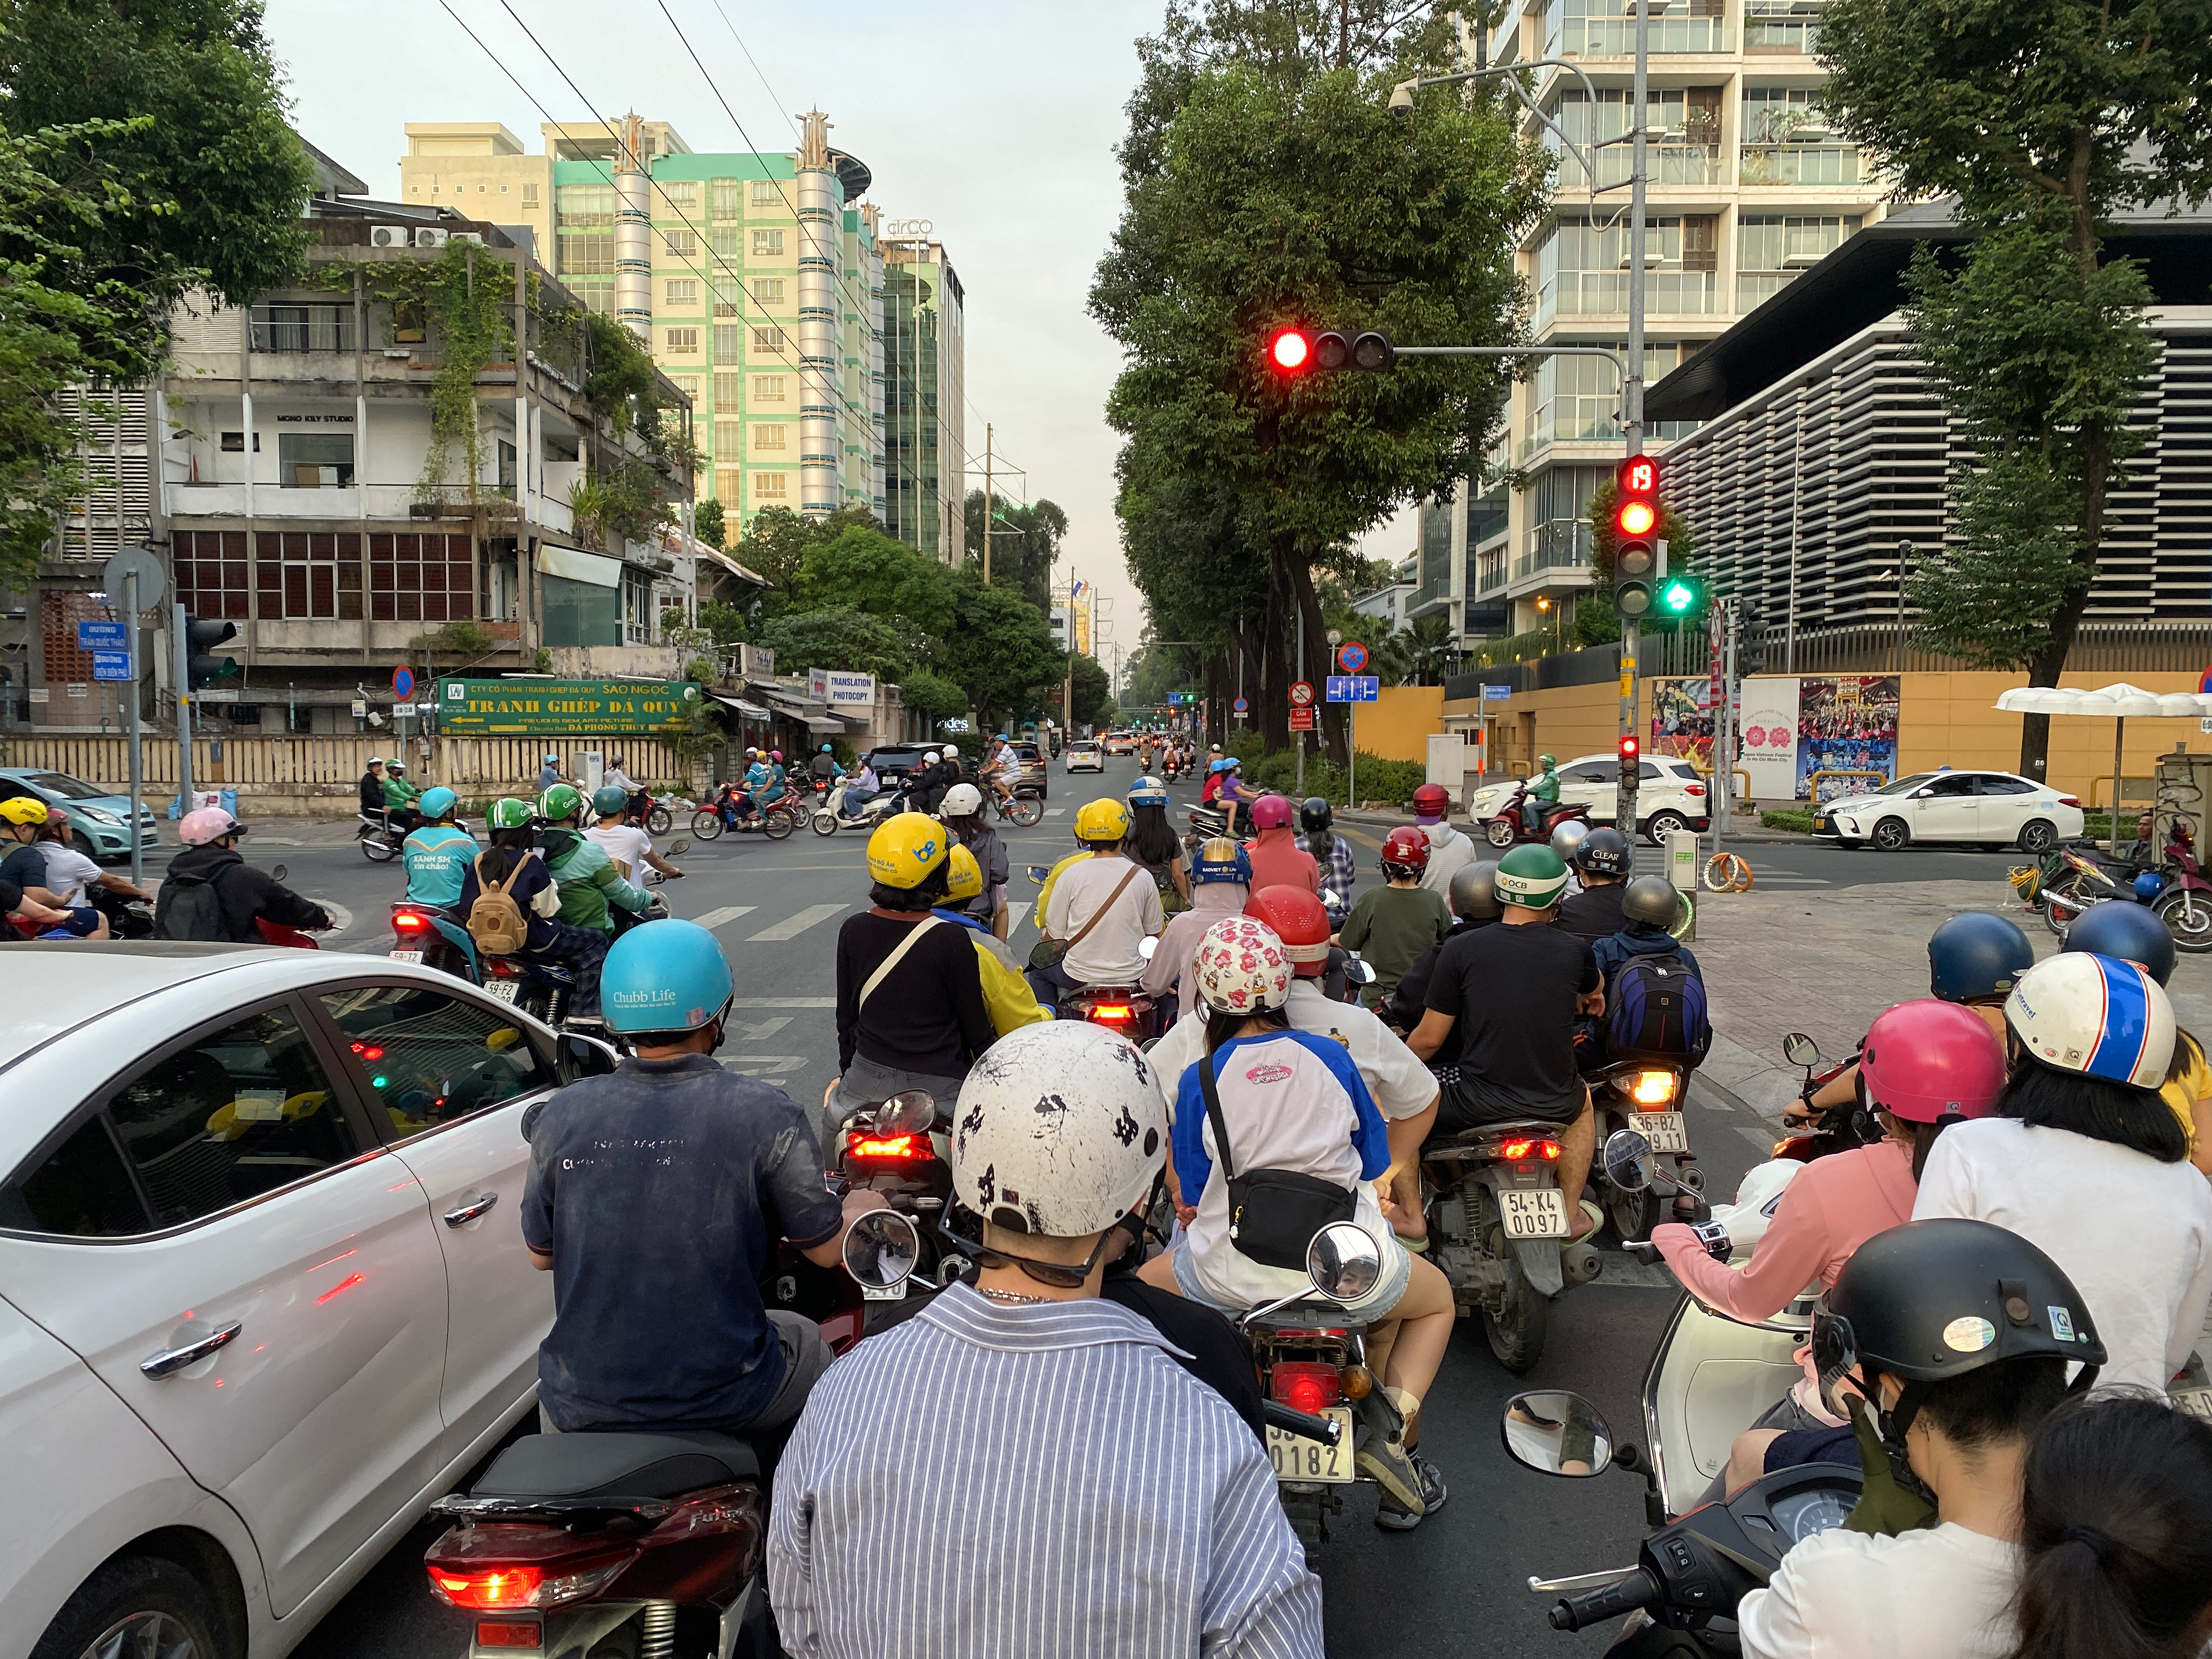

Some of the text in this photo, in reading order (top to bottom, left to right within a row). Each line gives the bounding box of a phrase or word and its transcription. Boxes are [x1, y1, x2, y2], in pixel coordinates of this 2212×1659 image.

[1633, 464, 1651, 490] 19
[831, 677, 871, 687] TRANSLATION
[602, 685, 628, 694] SAO
[631, 685, 670, 697] NGỌC
[833, 691, 867, 701] PHOTOCOPY
[466, 700, 539, 713] TRANH
[548, 697, 601, 713] GHÉP
[642, 697, 680, 713] QUÝ
[562, 797, 577, 809] Grab
[1592, 849, 1619, 861] CLEAR
[1508, 879, 1527, 889] OCB
[488, 984, 514, 995] 59-F2
[613, 989, 676, 1003] Chubb Life
[1509, 1192, 1555, 1212] 54-K4
[1513, 1214, 1558, 1234] 0097
[1270, 1444, 1339, 1476] 0182
